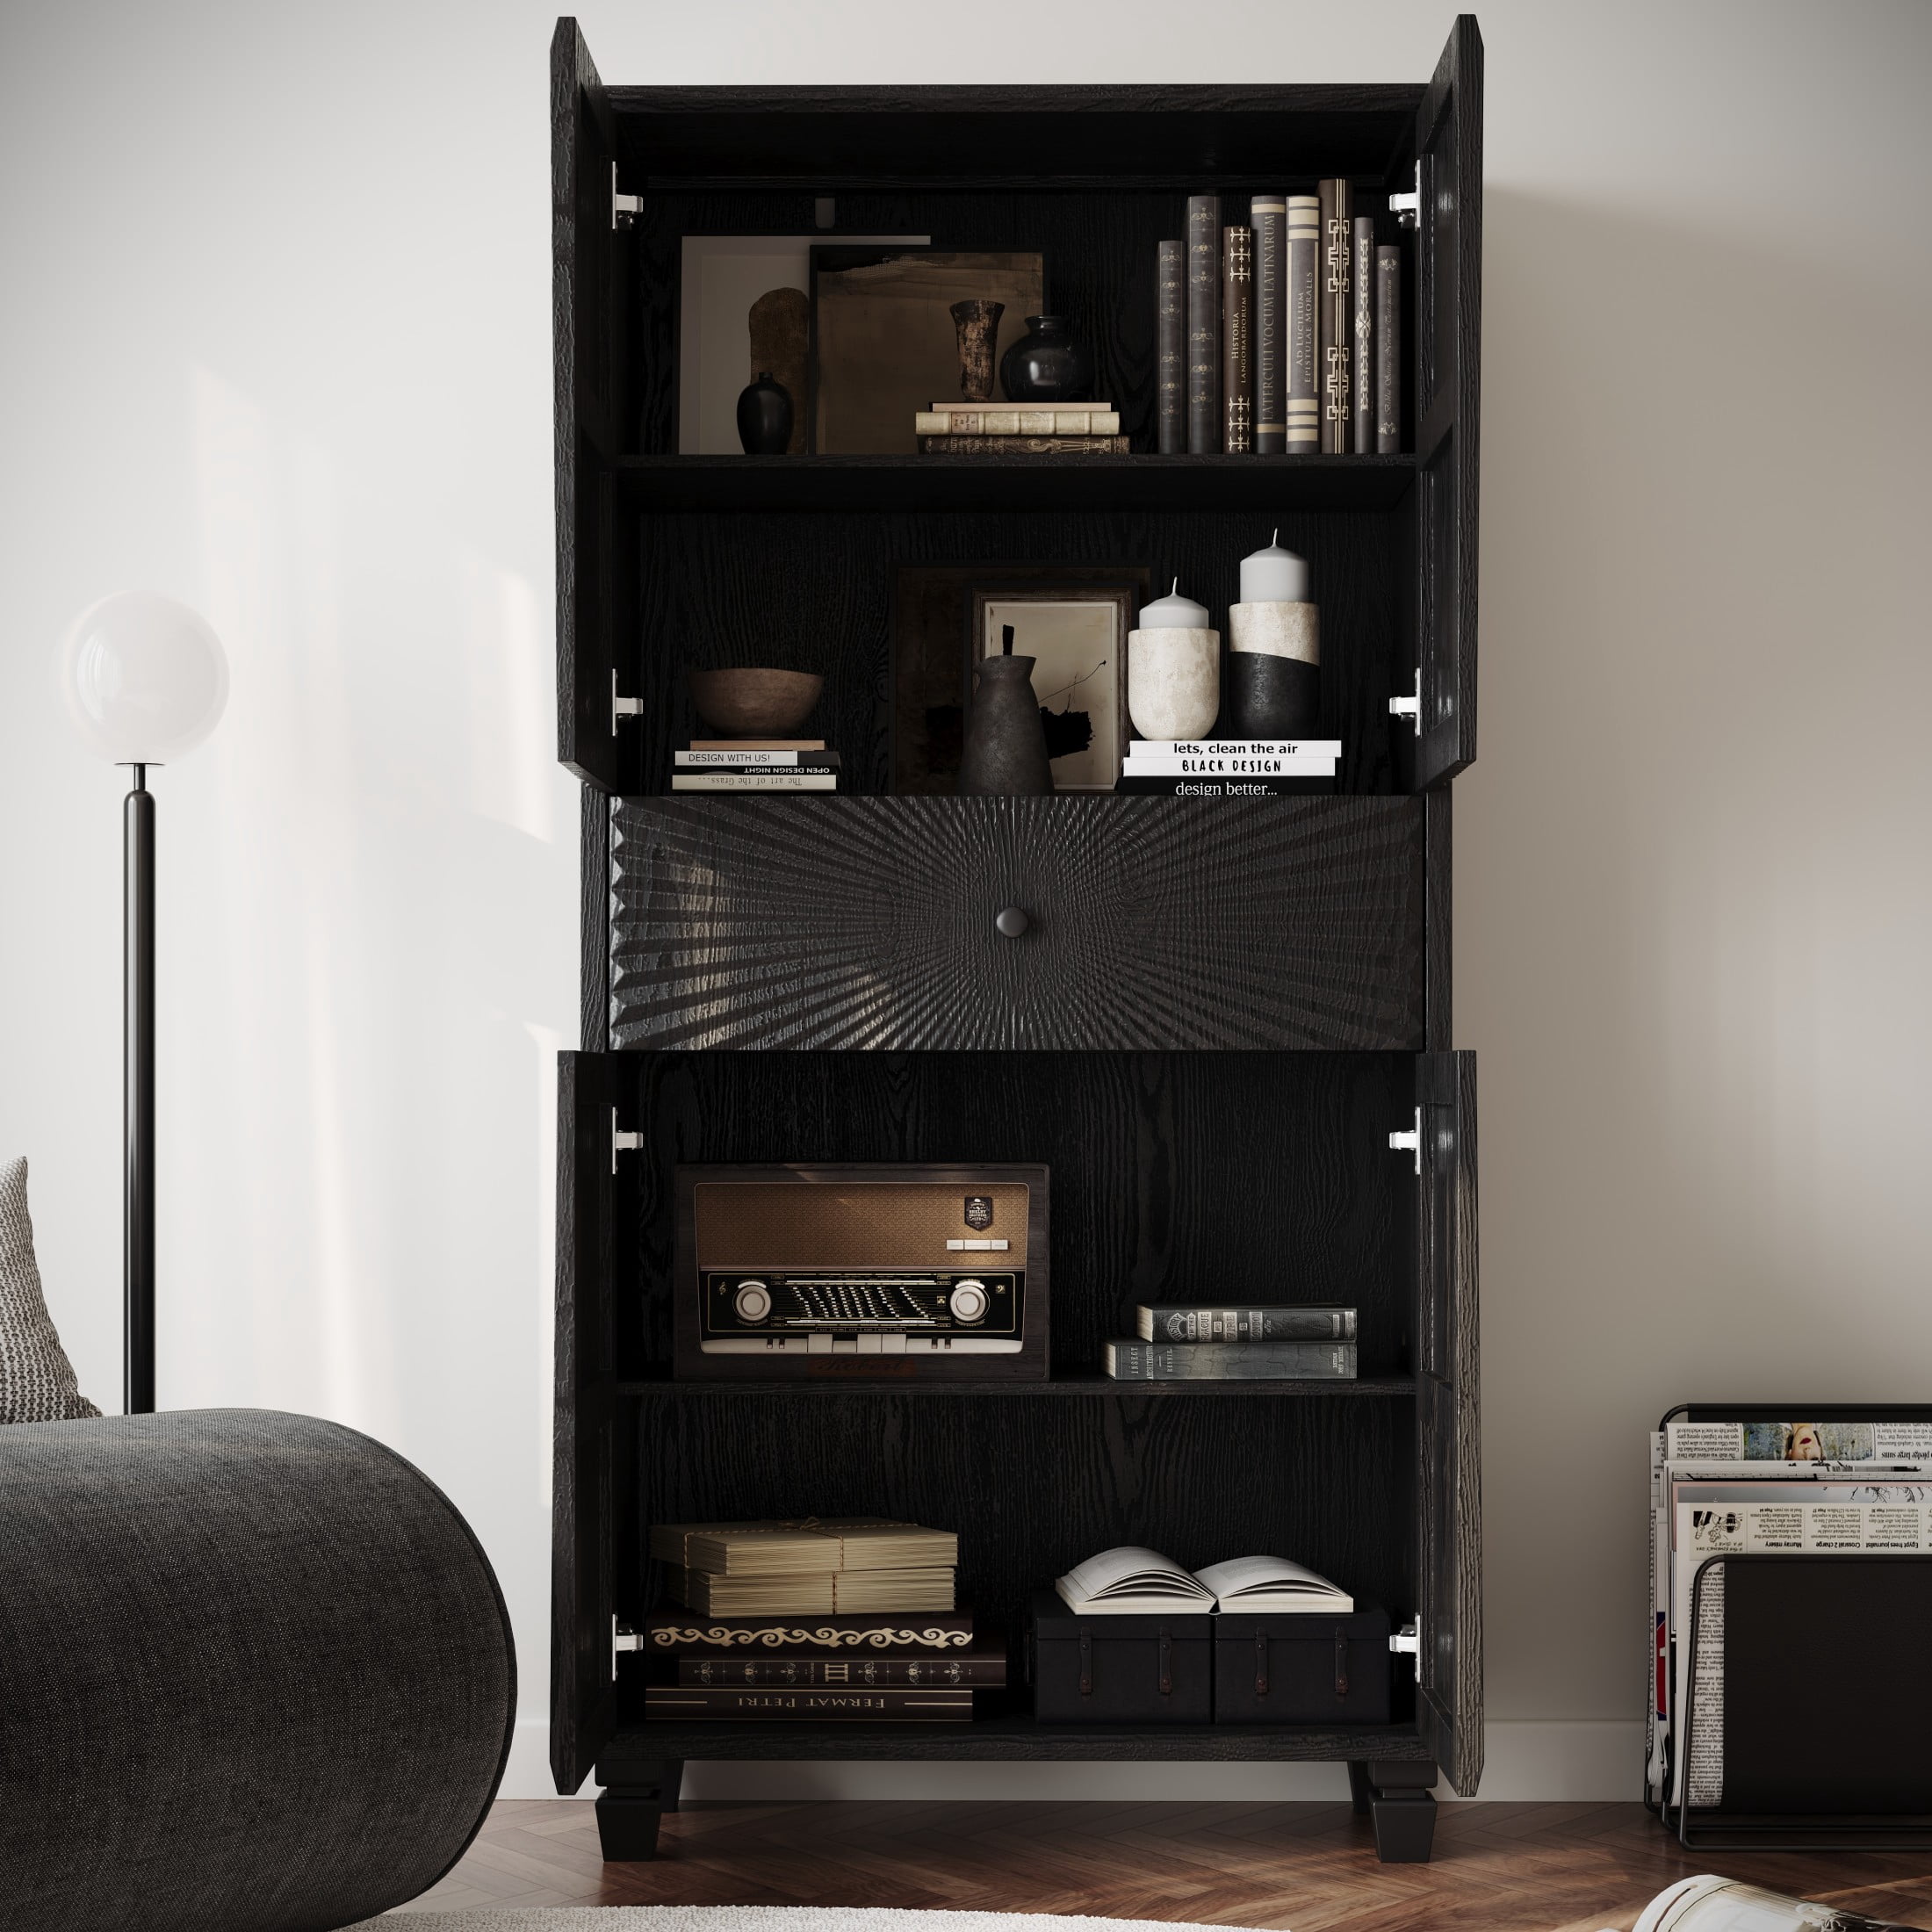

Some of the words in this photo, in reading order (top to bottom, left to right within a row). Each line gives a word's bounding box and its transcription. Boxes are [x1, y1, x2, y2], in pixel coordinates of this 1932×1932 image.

[1263, 215, 1275, 291] LATINARUM
[1263, 297, 1275, 346] VOCUM
[1296, 351, 1304, 366] AD
[1262, 351, 1274, 420] LATERCULI
[1174, 744, 1204, 755] lets,
[1209, 744, 1246, 753] clean
[1251, 744, 1274, 753] the
[1279, 744, 1298, 753] air
[1182, 760, 1224, 772] BLACK
[1233, 760, 1281, 772] DESIGN
[788, 777, 801, 786] The
[1176, 783, 1222, 796] design
[1167, 1314, 1182, 1339] HISTORY
[1200, 1313, 1210, 1341] PLAGUE
[1225, 1315, 1236, 1338] FIRE
[1882, 1451, 1896, 1460] sums
[1897, 1451, 1910, 1460] large
[1912, 1451, 1929, 1460] pledge
[824, 1663, 849, 1683] III
[738, 1698, 796, 1707] PETRI
[805, 1698, 885, 1709] FERMAT
